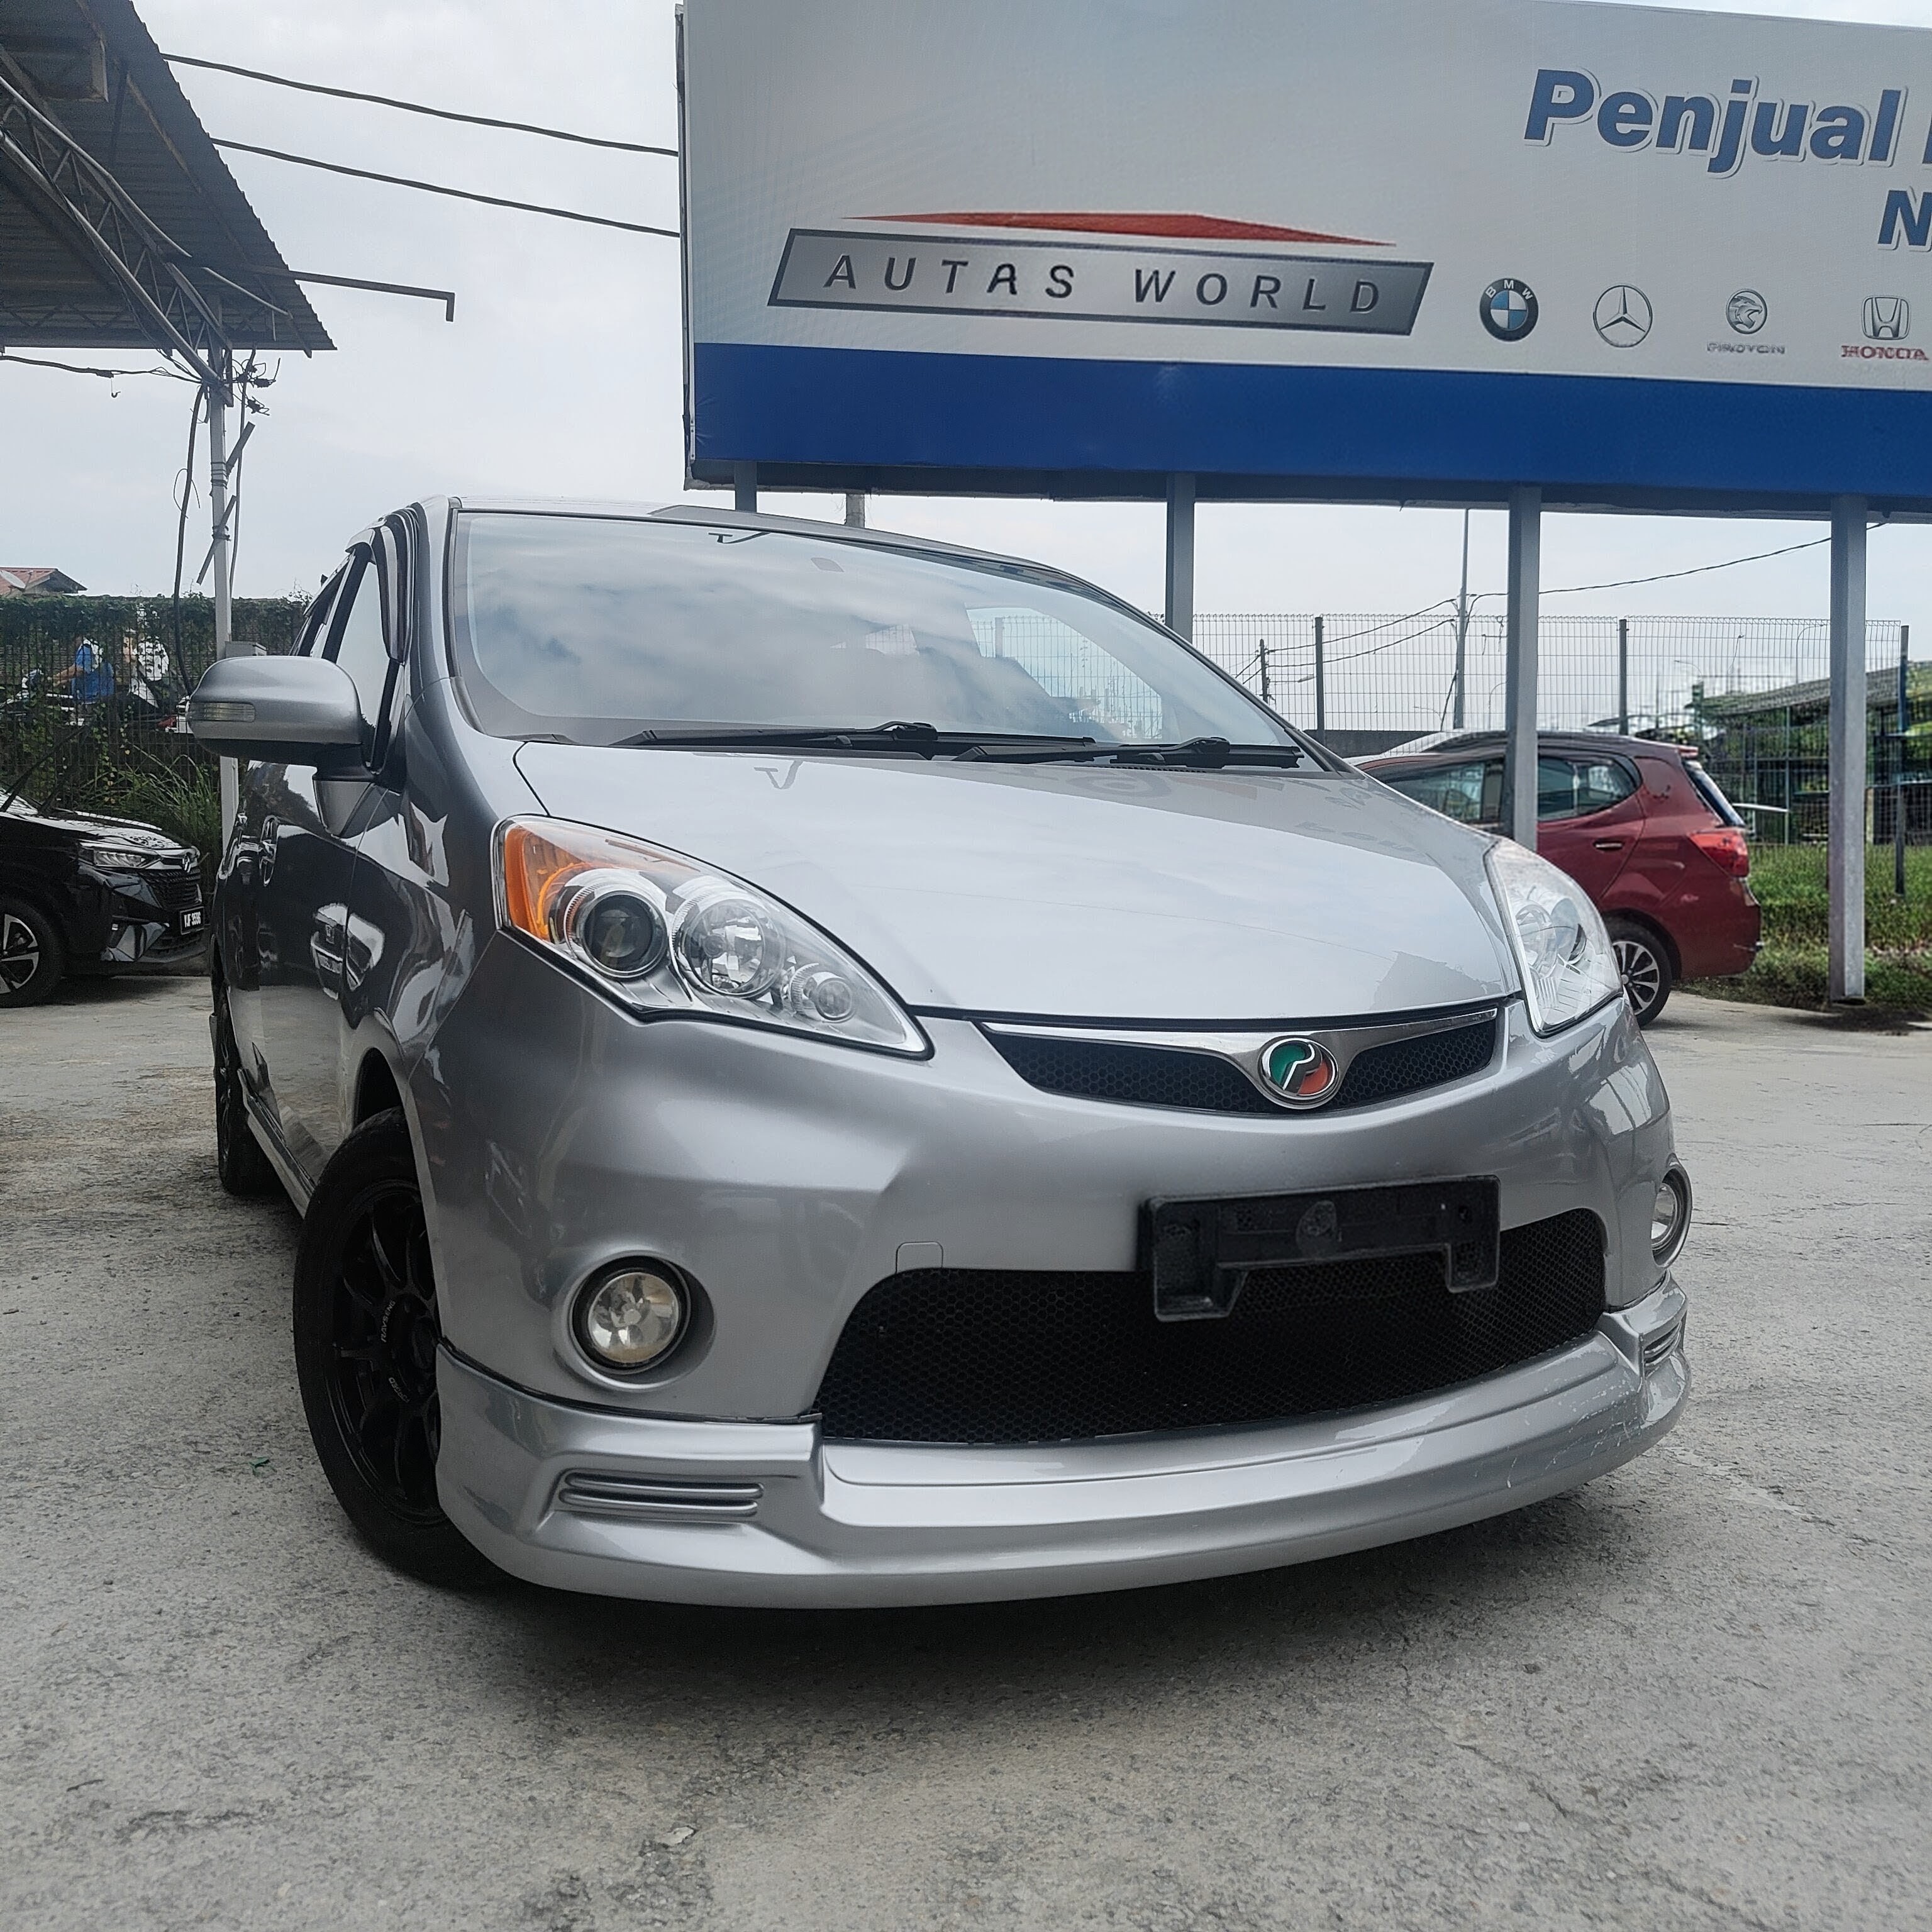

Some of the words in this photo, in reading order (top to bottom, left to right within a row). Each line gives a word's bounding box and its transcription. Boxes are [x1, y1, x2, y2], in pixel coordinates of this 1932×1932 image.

[1524, 69, 1904, 175] Penjual
[823, 254, 1075, 299] AUTAS
[1135, 269, 1380, 314] WORLD
[1485, 279, 1533, 300] BMW
[1707, 342, 1785, 354] PROTON
[1841, 345, 1929, 361] HONDA
